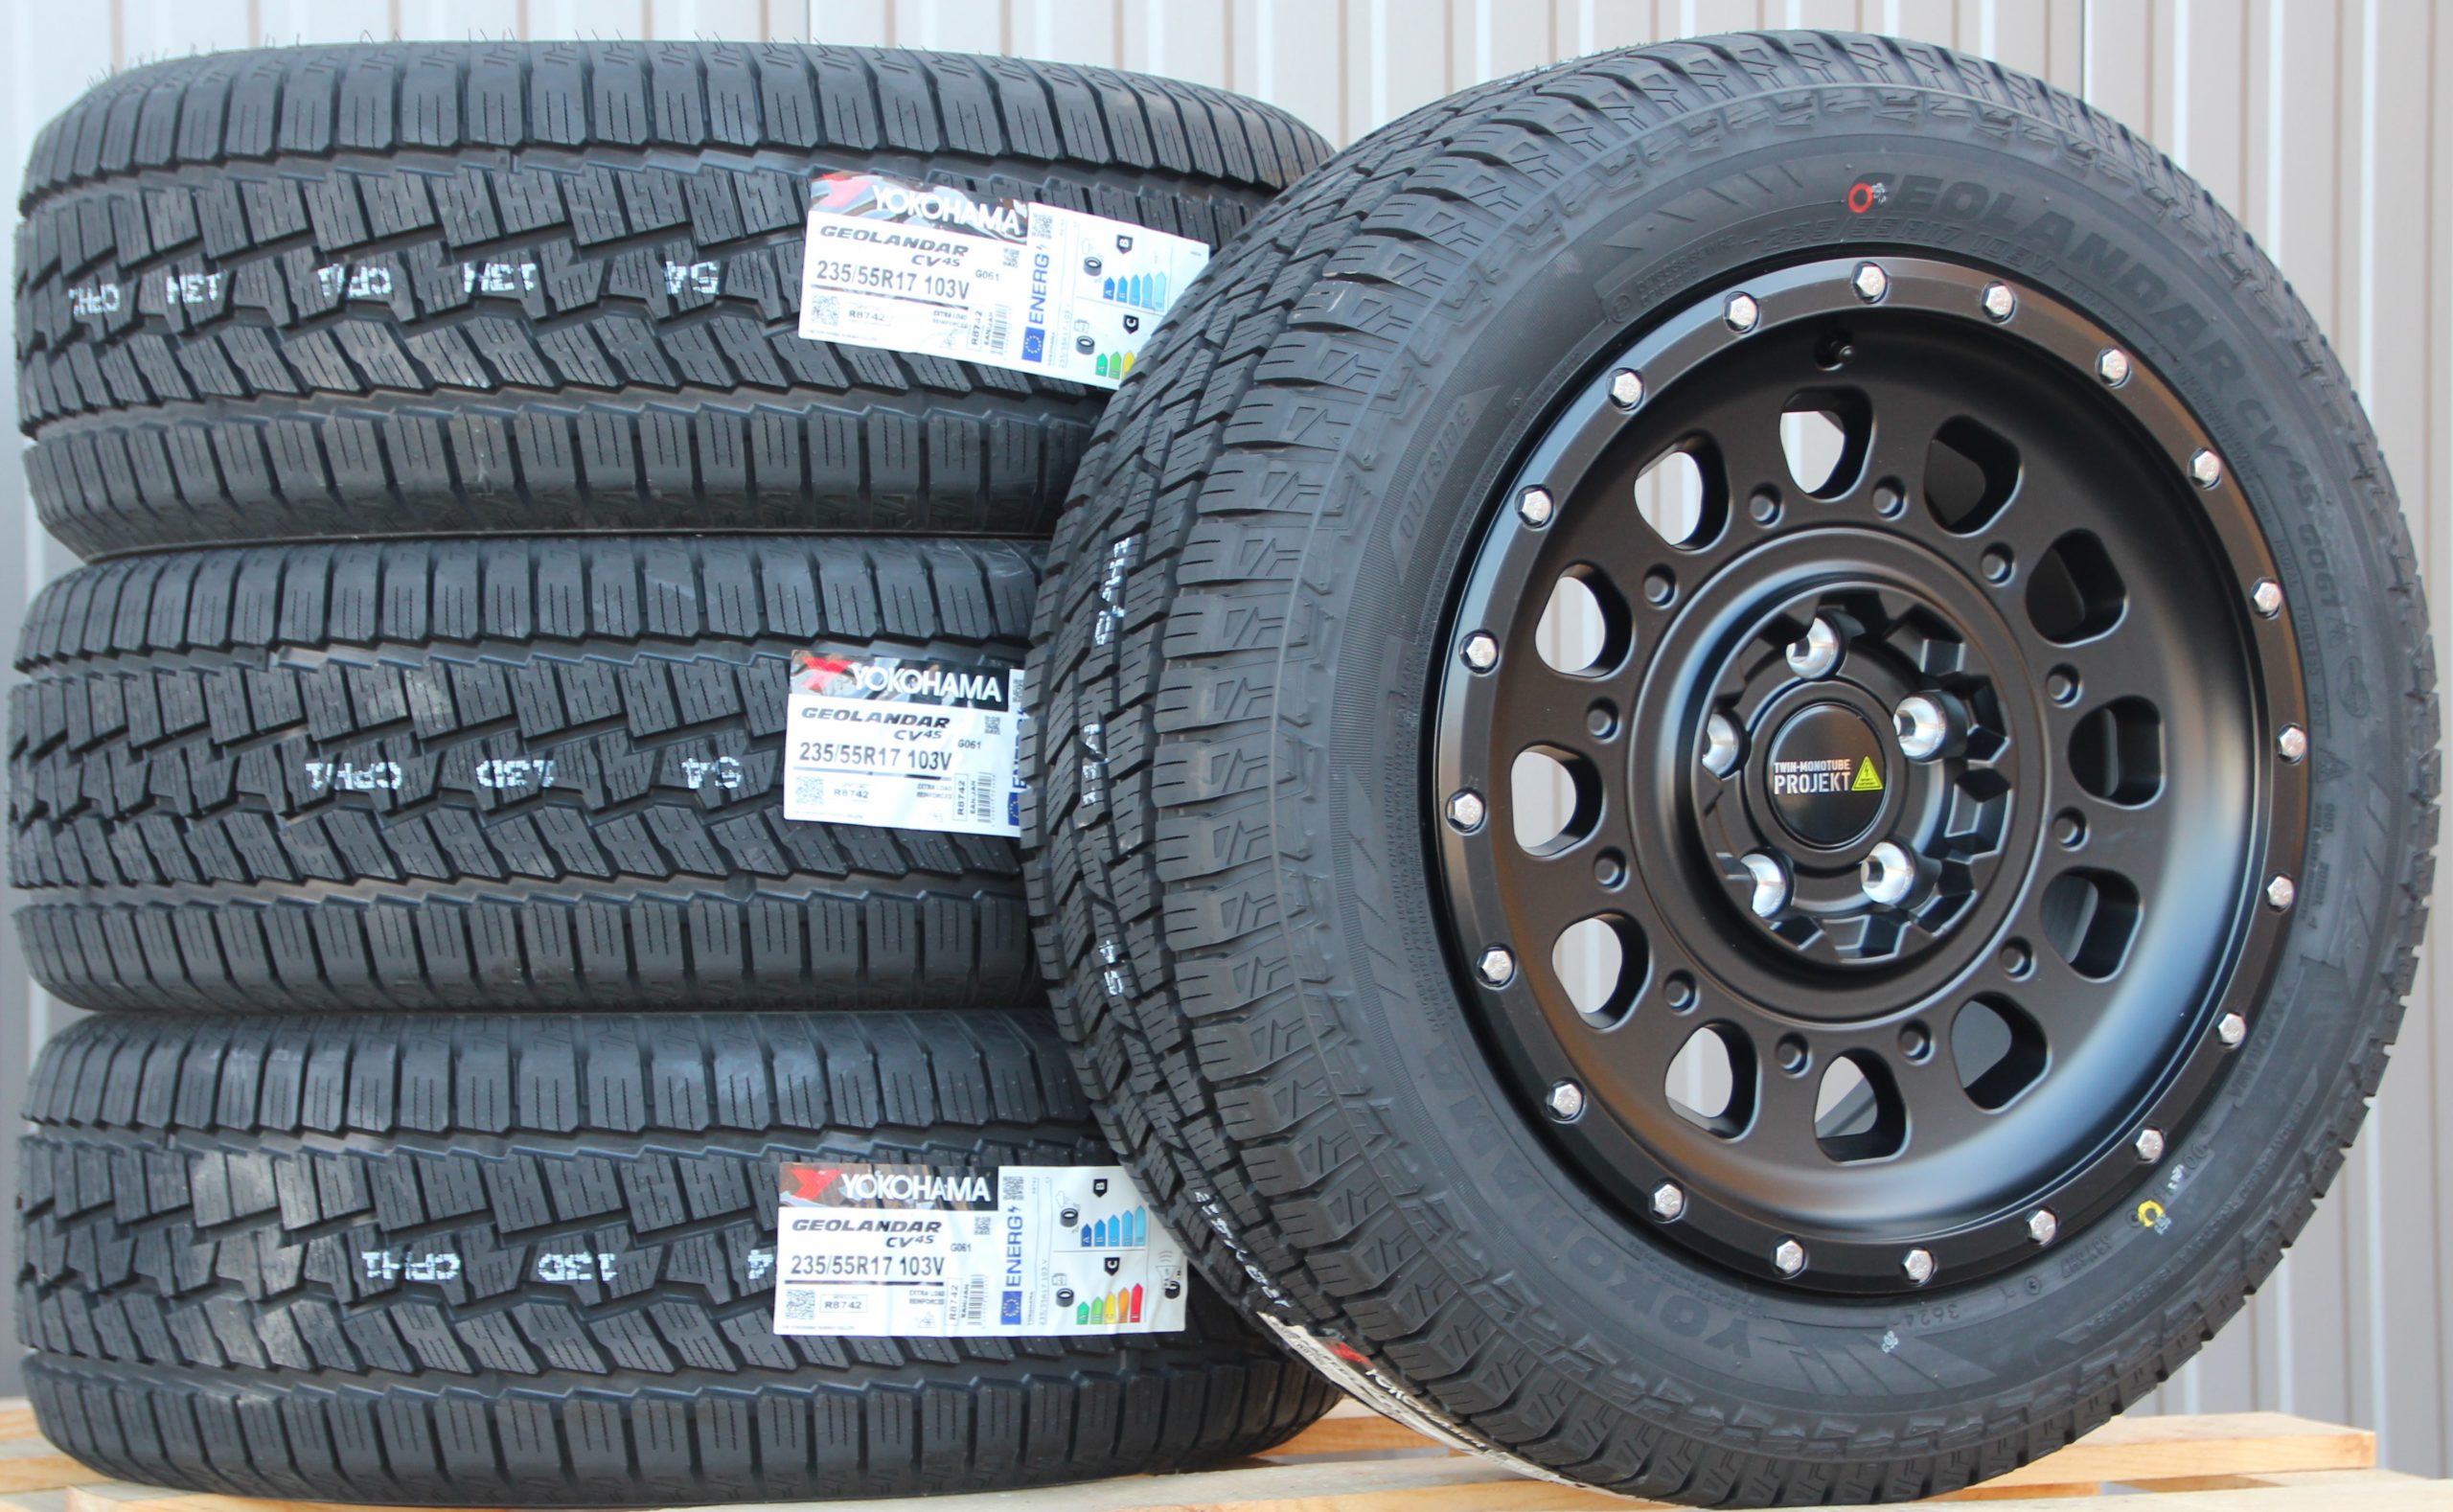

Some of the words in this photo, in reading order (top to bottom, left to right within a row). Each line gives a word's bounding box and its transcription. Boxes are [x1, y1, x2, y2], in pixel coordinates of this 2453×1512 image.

[873, 185, 1020, 237] YOKOHAMA
[820, 225, 969, 257] GEOLANDAR
[816, 260, 917, 292] 235/55R17
[925, 275, 970, 300] 103V
[974, 268, 1000, 282] G061
[1028, 252, 1050, 325] ENERG
[1399, 401, 1472, 540] OUTSIDE
[852, 661, 1002, 702] YOKOHAMA
[801, 707, 951, 729] GEOLANDAR
[799, 742, 901, 767] 235/55R17
[907, 750, 952, 770] 103V
[958, 740, 981, 749] G061
[1774, 759, 1851, 772] TWIN-MONOTUBE
[1774, 772, 1851, 794] PROJEKT
[841, 1174, 992, 1203] YOKOHAMA
[1428, 1041, 1753, 1359] YOKOHAMA
[792, 1219, 943, 1233] GEOLANDAR
[791, 1255, 892, 1275] 235/55R17
[899, 1256, 945, 1276] 103V
[1005, 1215, 1024, 1287] ENERG
